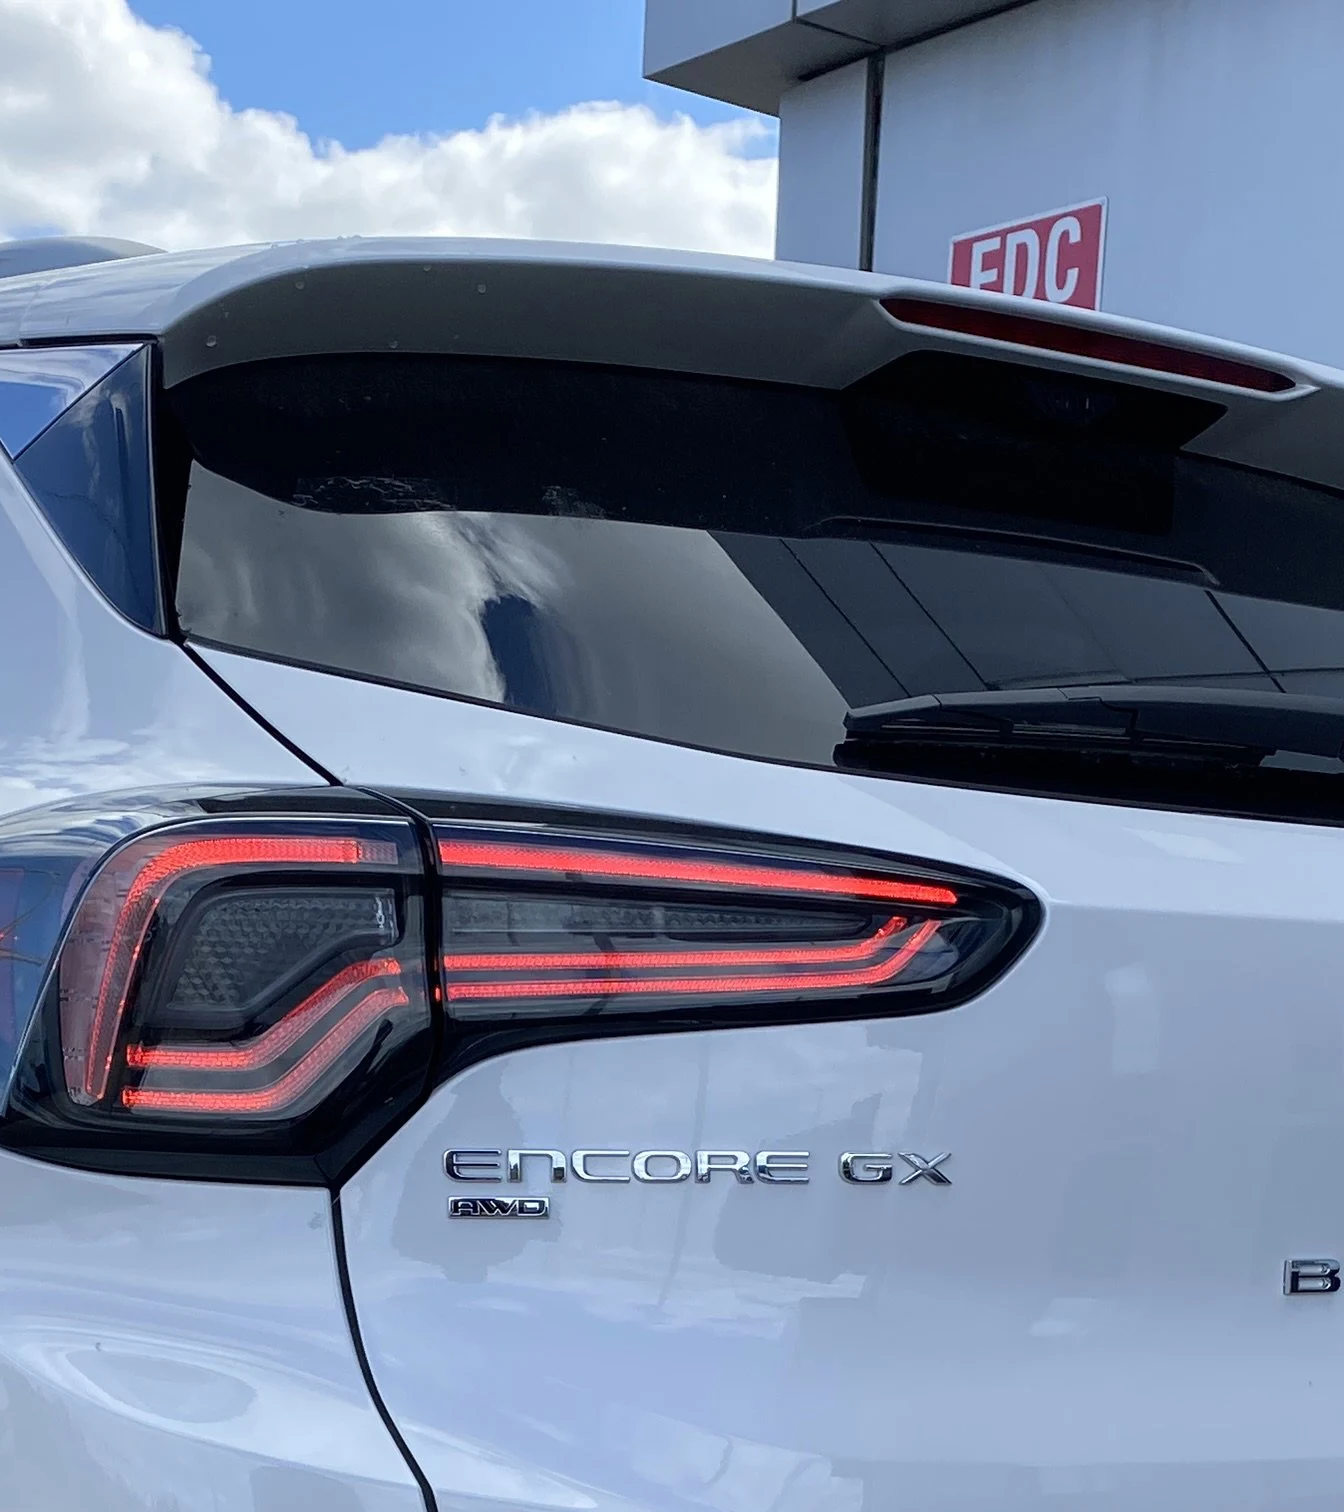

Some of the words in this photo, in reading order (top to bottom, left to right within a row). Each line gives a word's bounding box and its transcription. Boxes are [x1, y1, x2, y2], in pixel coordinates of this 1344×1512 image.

[442, 1149, 810, 1184] ENCORE
[838, 1152, 952, 1186] GX
[450, 1198, 548, 1218] AWD
